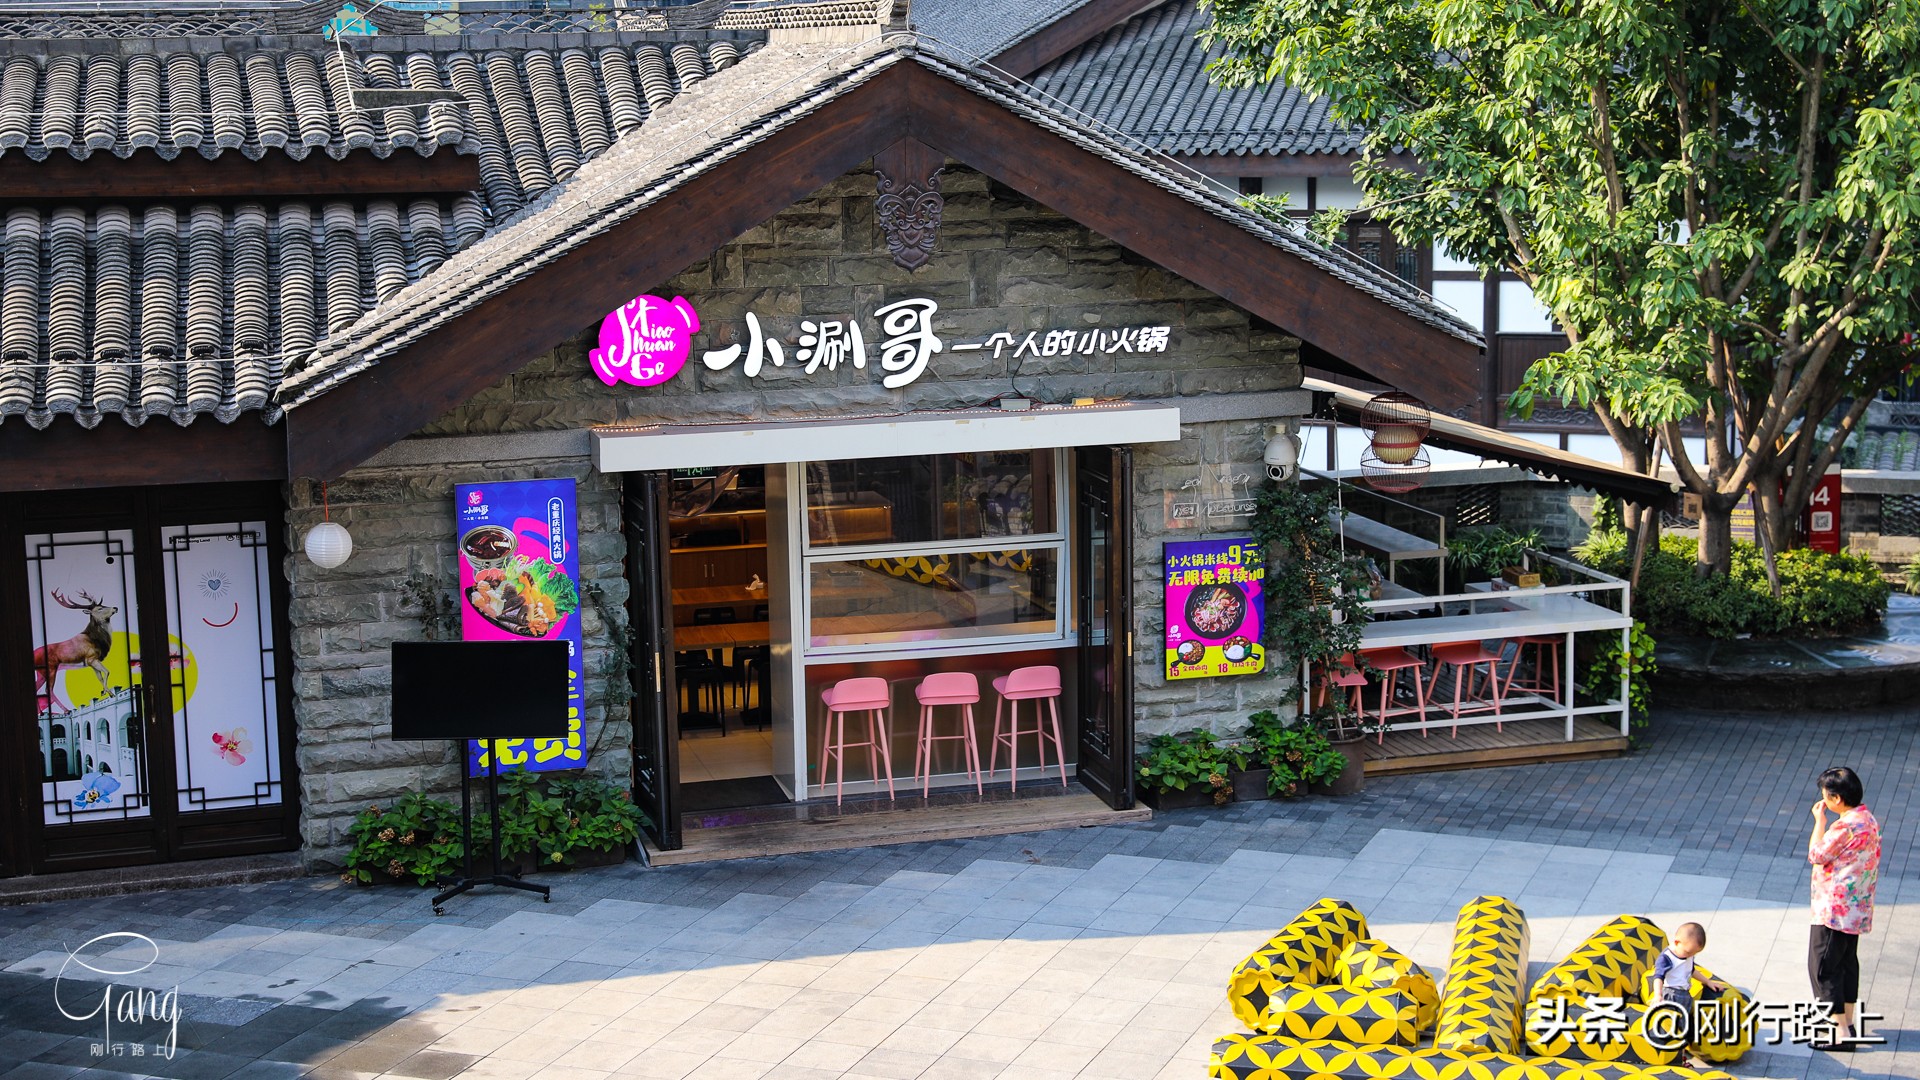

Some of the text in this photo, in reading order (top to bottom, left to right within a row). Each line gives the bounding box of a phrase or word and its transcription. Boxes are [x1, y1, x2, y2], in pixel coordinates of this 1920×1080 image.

[702, 297, 1171, 389] 小涮哥 一个人的小火锅
[630, 352, 665, 380] Ge
[551, 502, 562, 559] 老重庆经典火锅
[1168, 566, 1265, 587] 无限免费续加
[1168, 666, 1180, 677] 15
[1217, 663, 1229, 673] 18
